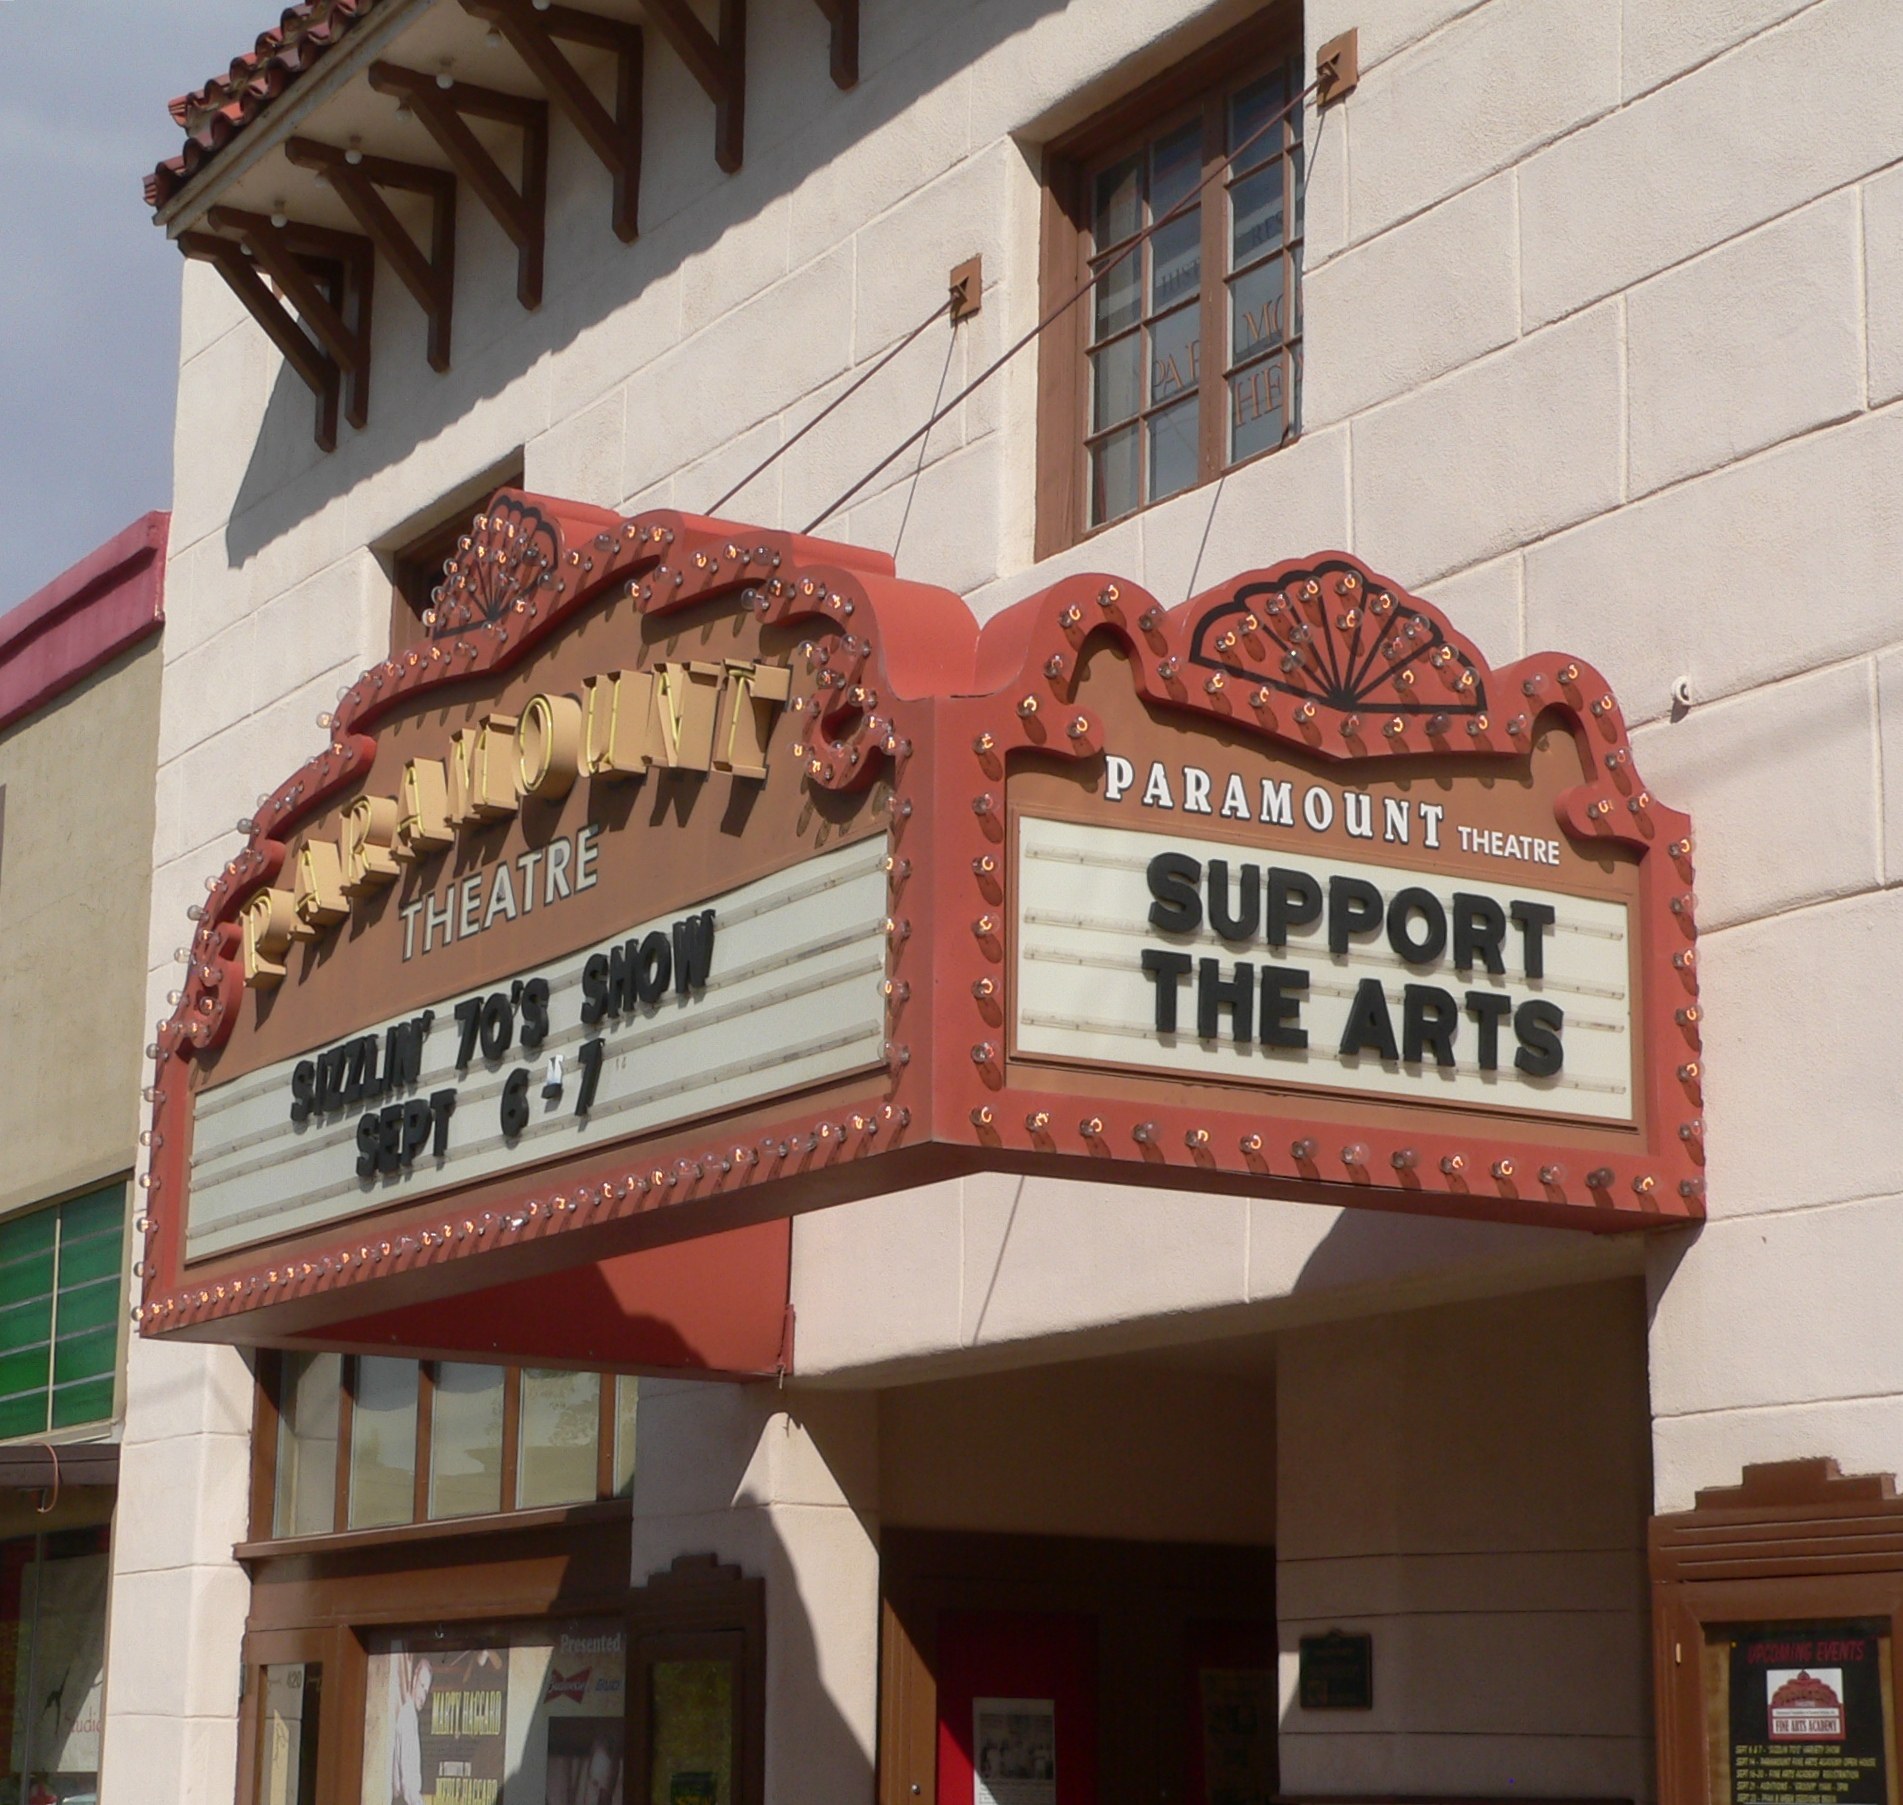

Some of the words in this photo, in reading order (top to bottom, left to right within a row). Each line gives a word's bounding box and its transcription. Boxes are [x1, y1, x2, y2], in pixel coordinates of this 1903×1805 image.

[242, 657, 791, 989] PARAMOUNT
[1104, 753, 1445, 849] PARAMOUNT
[1457, 825, 1561, 866] THEATRE
[400, 823, 600, 962] THEATRE
[1146, 851, 1556, 980] SUPPORT
[454, 977, 550, 1070] 70'S
[580, 908, 716, 1025] SHOW
[1141, 948, 1310, 1049] THE
[1338, 977, 1565, 1079] ARTS
[356, 1087, 458, 1178] SEPT
[1816, 1640, 1866, 1661] EVENTS
[1776, 1719, 1789, 1732] FINE
[1808, 1719, 1837, 1732] ACADEMY
